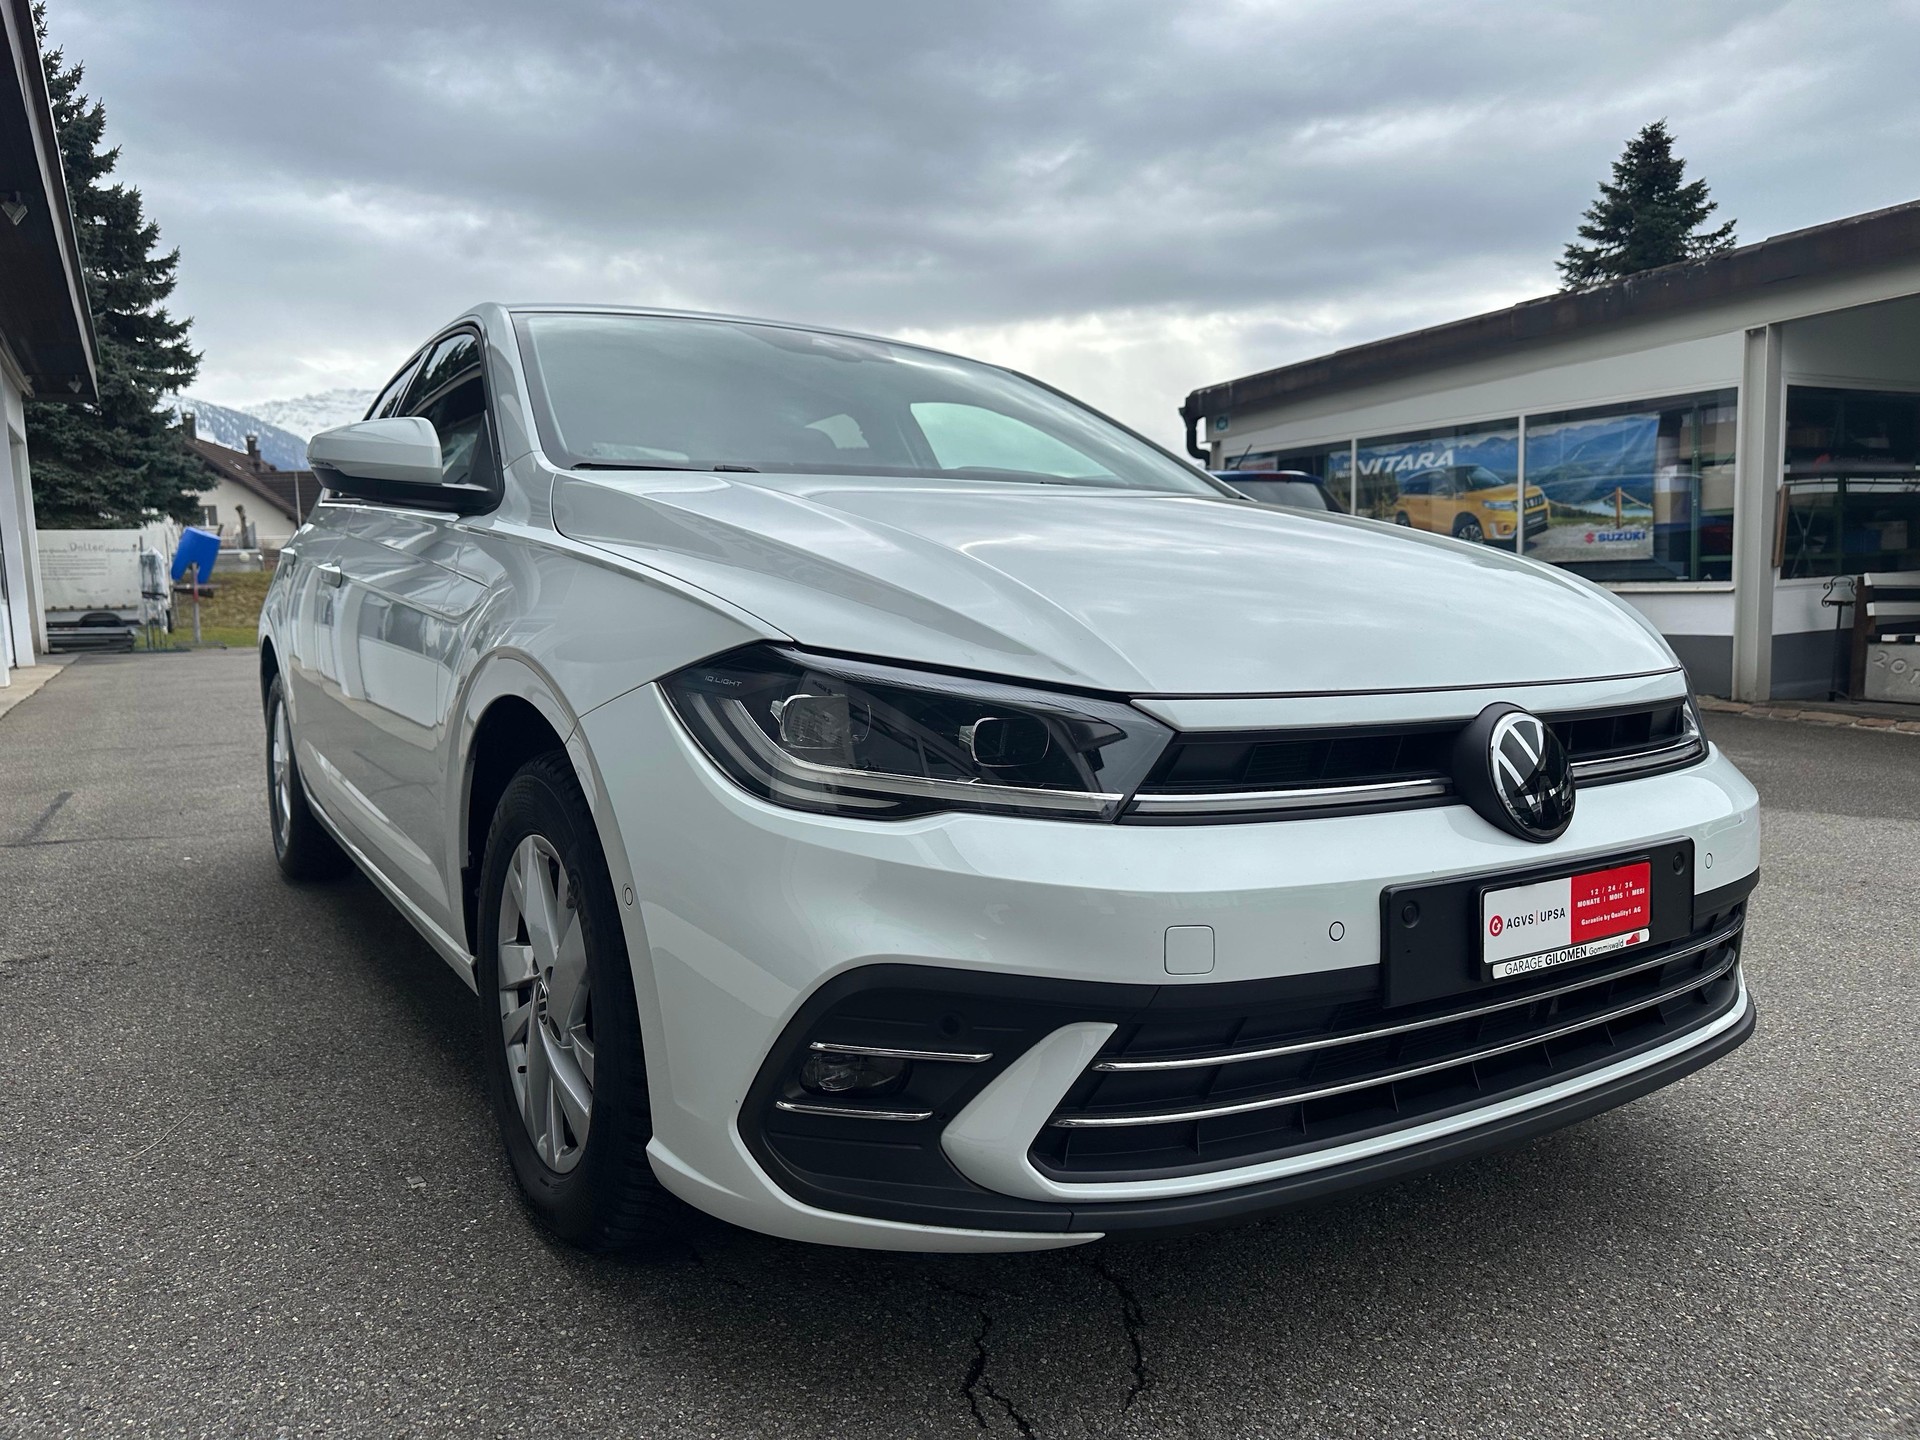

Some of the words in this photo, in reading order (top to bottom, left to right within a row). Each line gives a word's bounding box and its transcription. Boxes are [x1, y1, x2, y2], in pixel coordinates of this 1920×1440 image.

[1358, 449, 1454, 475] VITARA
[1598, 530, 1646, 542] SUZUKI
[1873, 649, 1920, 684] 201
[1577, 897, 1600, 908] MONATE
[1609, 892, 1623, 901] MOIS
[1632, 887, 1645, 896] MESI
[1591, 888, 1599, 896] 12
[1625, 881, 1633, 889] 36
[1581, 916, 1603, 926] Garantie
[1633, 906, 1641, 914] AG
[1504, 956, 1543, 975] GARAGE
[1545, 946, 1587, 966] GILOMEN
[1588, 939, 1624, 955] Gommiswald
